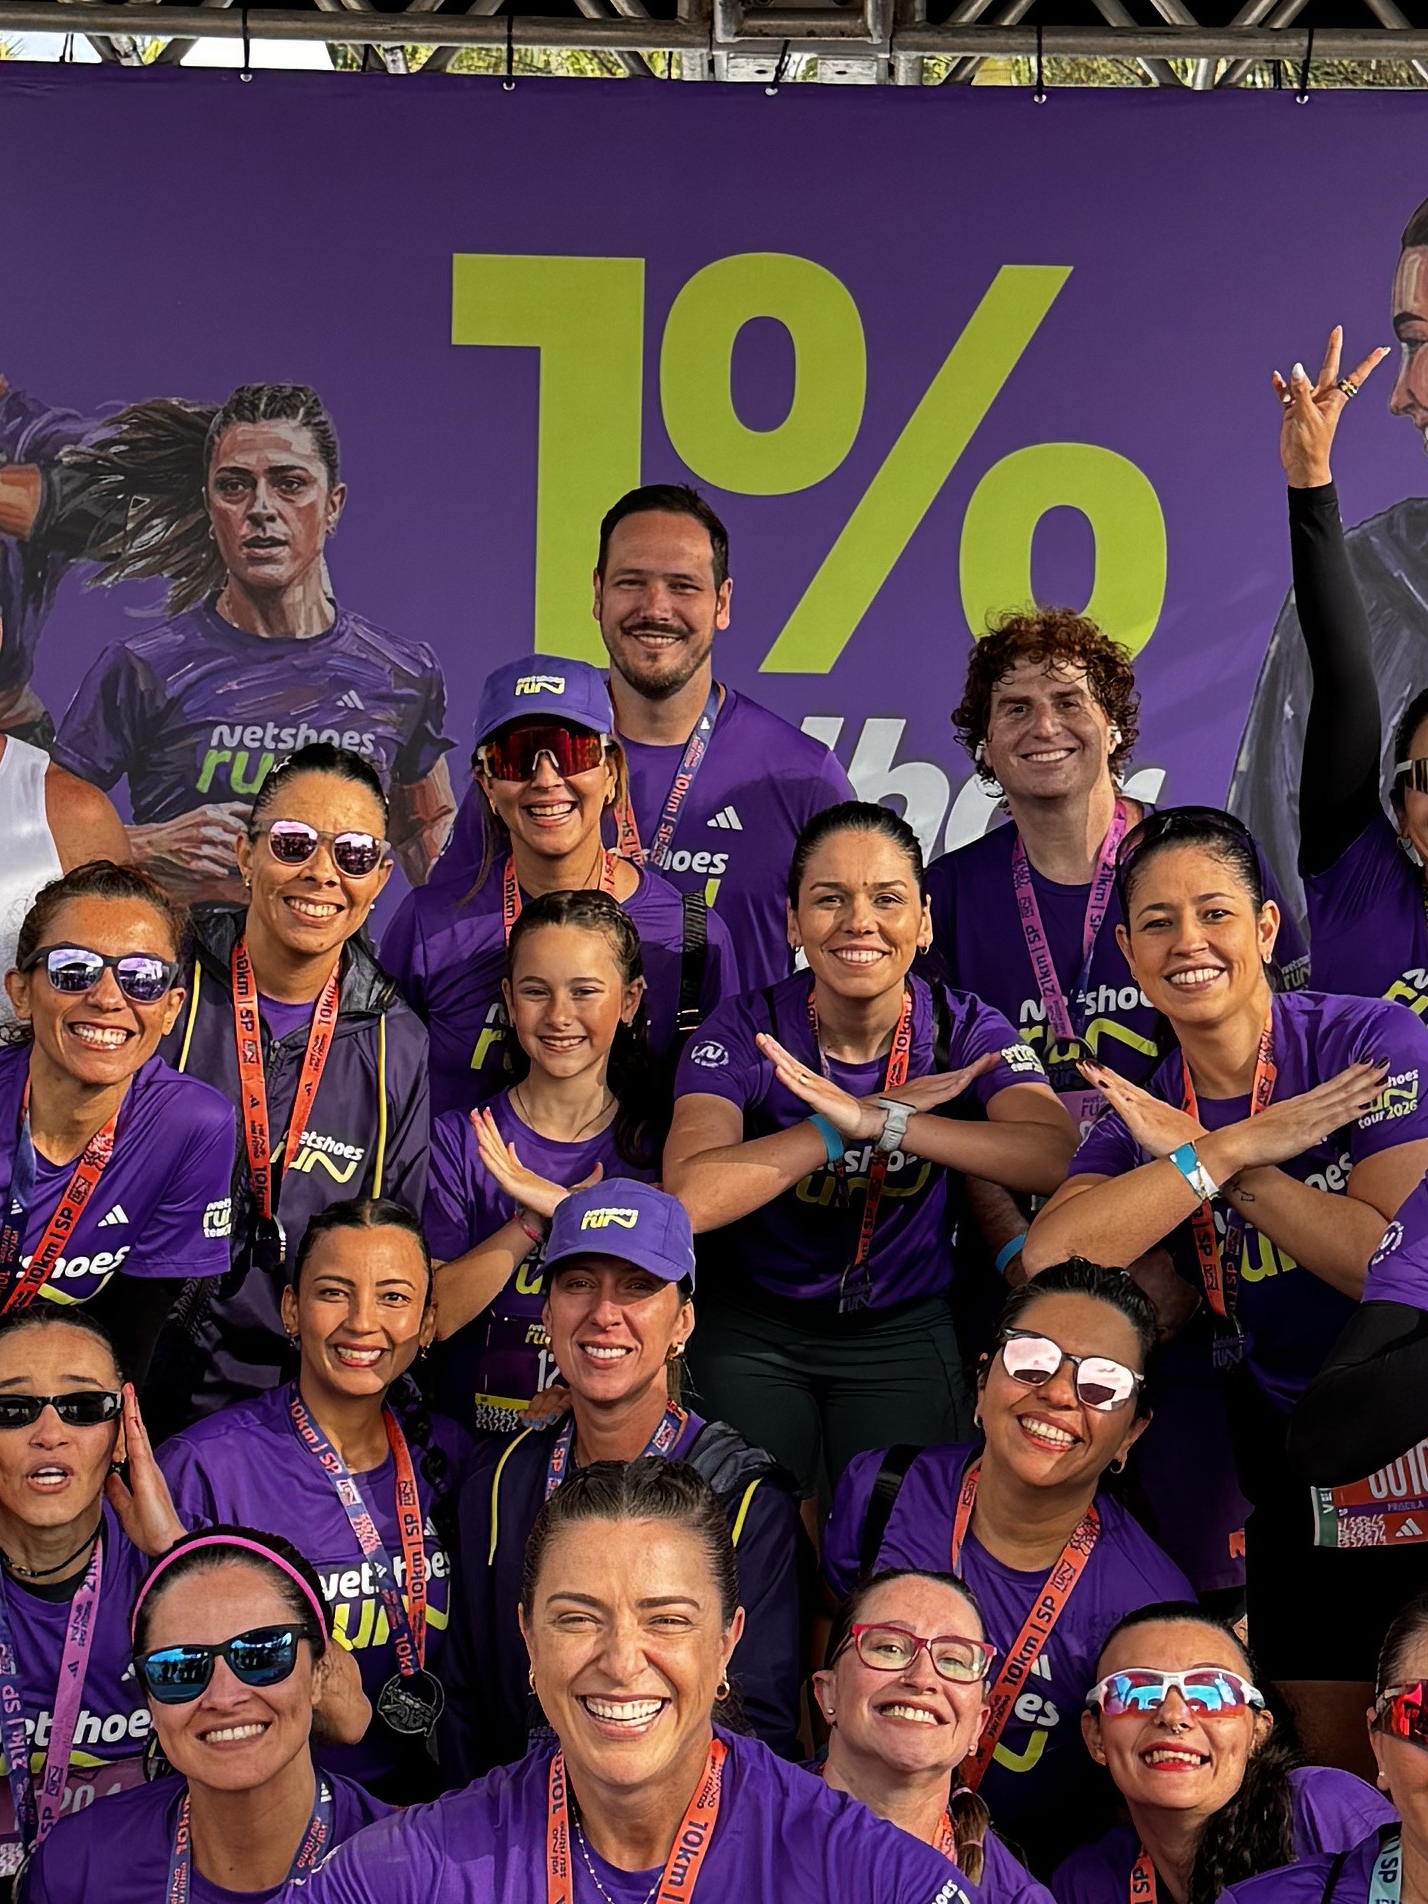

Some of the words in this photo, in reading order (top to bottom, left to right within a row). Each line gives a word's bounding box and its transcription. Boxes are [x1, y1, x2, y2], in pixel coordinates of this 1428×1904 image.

[452, 251, 1168, 674] 1%
[196, 749, 272, 797] ru
[1093, 863, 1116, 902] 21km
[1026, 924, 1042, 946] SP
[233, 947, 250, 996] 10km
[1035, 956, 1061, 997] 21km
[318, 974, 338, 1025] 10km
[239, 1008, 255, 1034] SP
[1358, 1109, 1385, 1130] tour
[1385, 1099, 1419, 1121] 2026
[299, 1131, 365, 1162] etshoes
[796, 1162, 932, 1206] un
[581, 1214, 639, 1230] run
[24, 1239, 62, 1287] 10km
[55, 1206, 74, 1231] SP
[1194, 1237, 1211, 1265] SP
[289, 1397, 320, 1451] 10km
[318, 1451, 343, 1475] SP
[551, 1445, 569, 1474] SP
[406, 1512, 421, 1538] SP
[409, 1554, 425, 1604] 10km
[1001, 1635, 1039, 1688] 10km
[1036, 1594, 1057, 1624] SP
[1, 1685, 22, 1714] SP
[40, 1806, 60, 1835] SP
[670, 1819, 710, 1888] 10km
[1378, 1856, 1400, 1884] SP
[1131, 1866, 1151, 1895] SP
